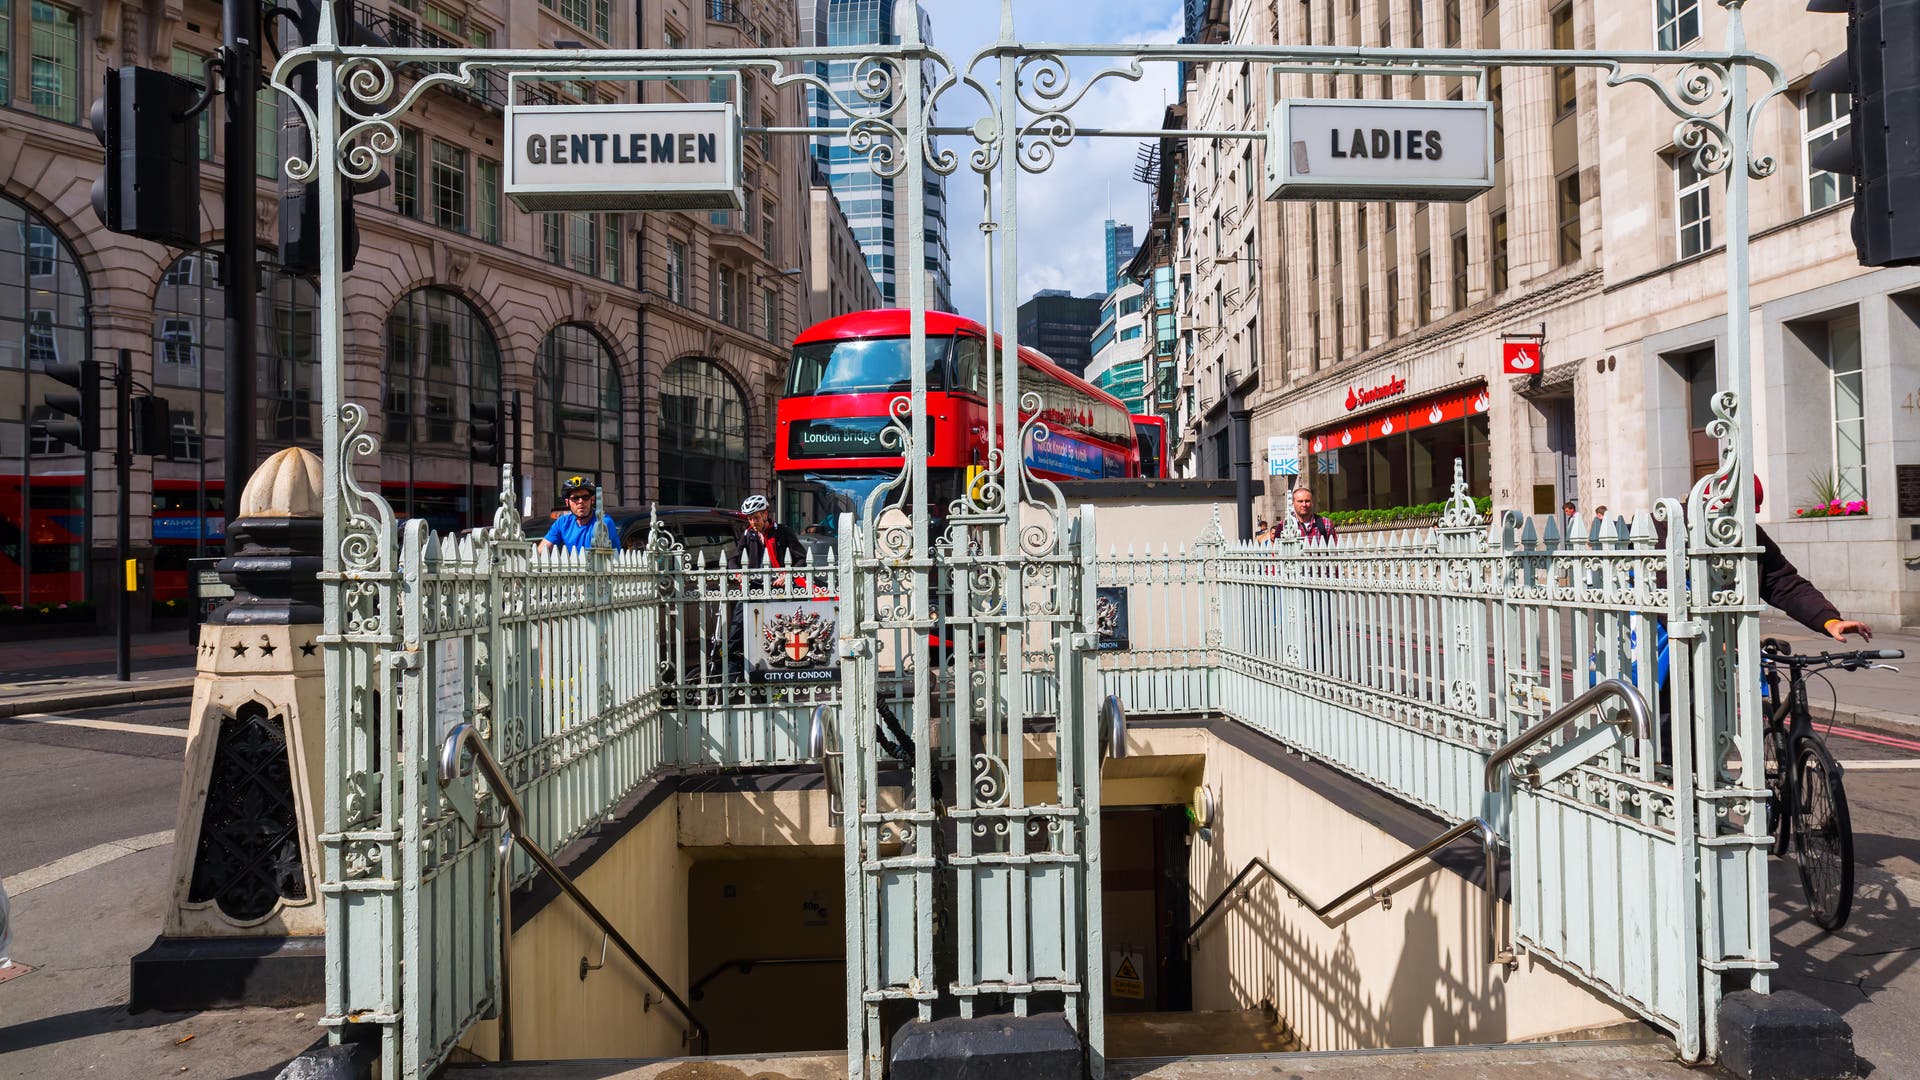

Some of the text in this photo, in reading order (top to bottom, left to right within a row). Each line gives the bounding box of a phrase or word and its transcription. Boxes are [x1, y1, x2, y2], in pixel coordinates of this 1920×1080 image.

[526, 133, 716, 164] GENTLEMEN
[1331, 129, 1443, 161] LADIES
[1358, 375, 1407, 406] Santander
[804, 430, 876, 445] London Bridge
[1596, 478, 1605, 488] 51
[1501, 489, 1509, 498] 51
[764, 671, 832, 680] CITY OF LONDON
